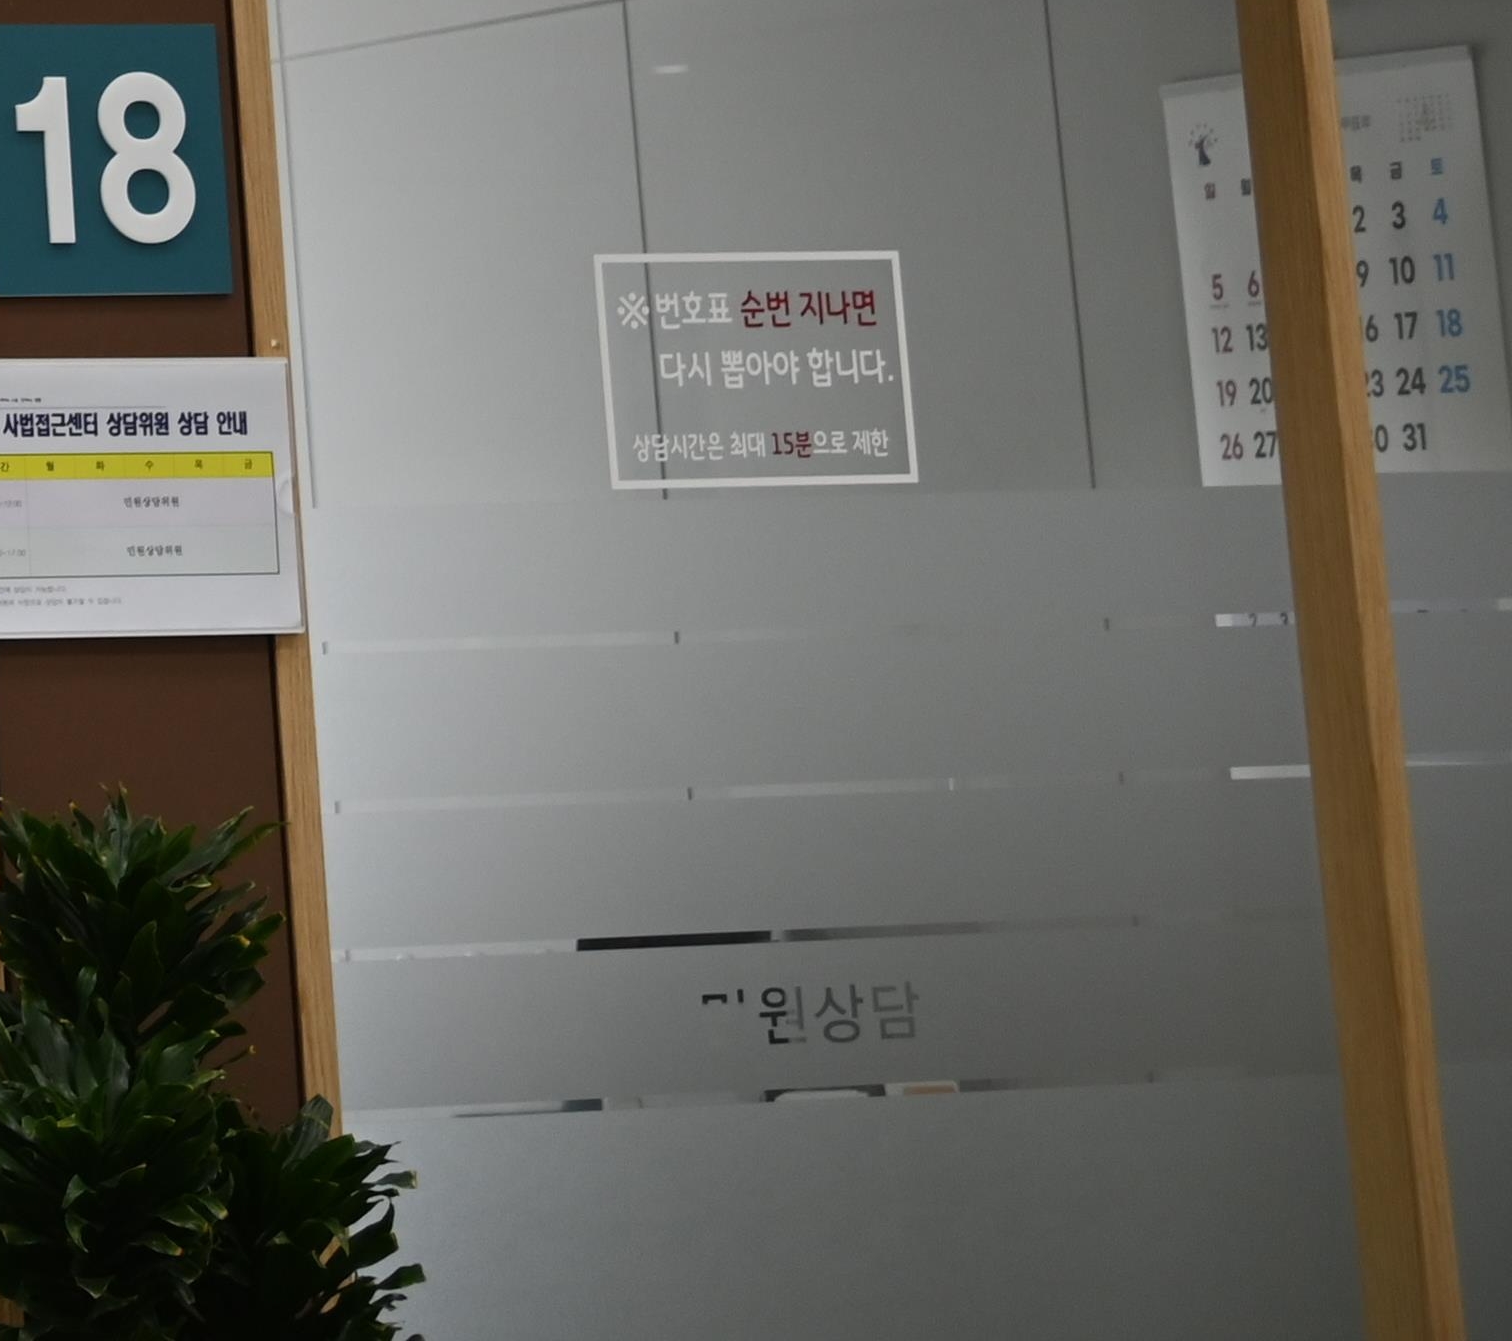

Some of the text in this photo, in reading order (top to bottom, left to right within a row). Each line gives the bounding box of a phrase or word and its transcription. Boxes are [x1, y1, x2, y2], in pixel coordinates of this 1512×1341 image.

[15, 71, 196, 244] 18
[1392, 202, 1405, 229] 3
[1389, 253, 1454, 284] 10 11
[741, 291, 791, 328] 순번
[800, 290, 877, 326] 지나면
[1212, 309, 1462, 353] 12 17 18
[660, 348, 894, 389] 다시 뽑아야 합니다.
[1216, 365, 1470, 407] 19 24 25
[3, 411, 247, 438] 사법접근센터 상담위원 상담 안내
[1403, 423, 1427, 450] 31
[633, 429, 888, 462] 상담시간은 최대 15분으로 제한
